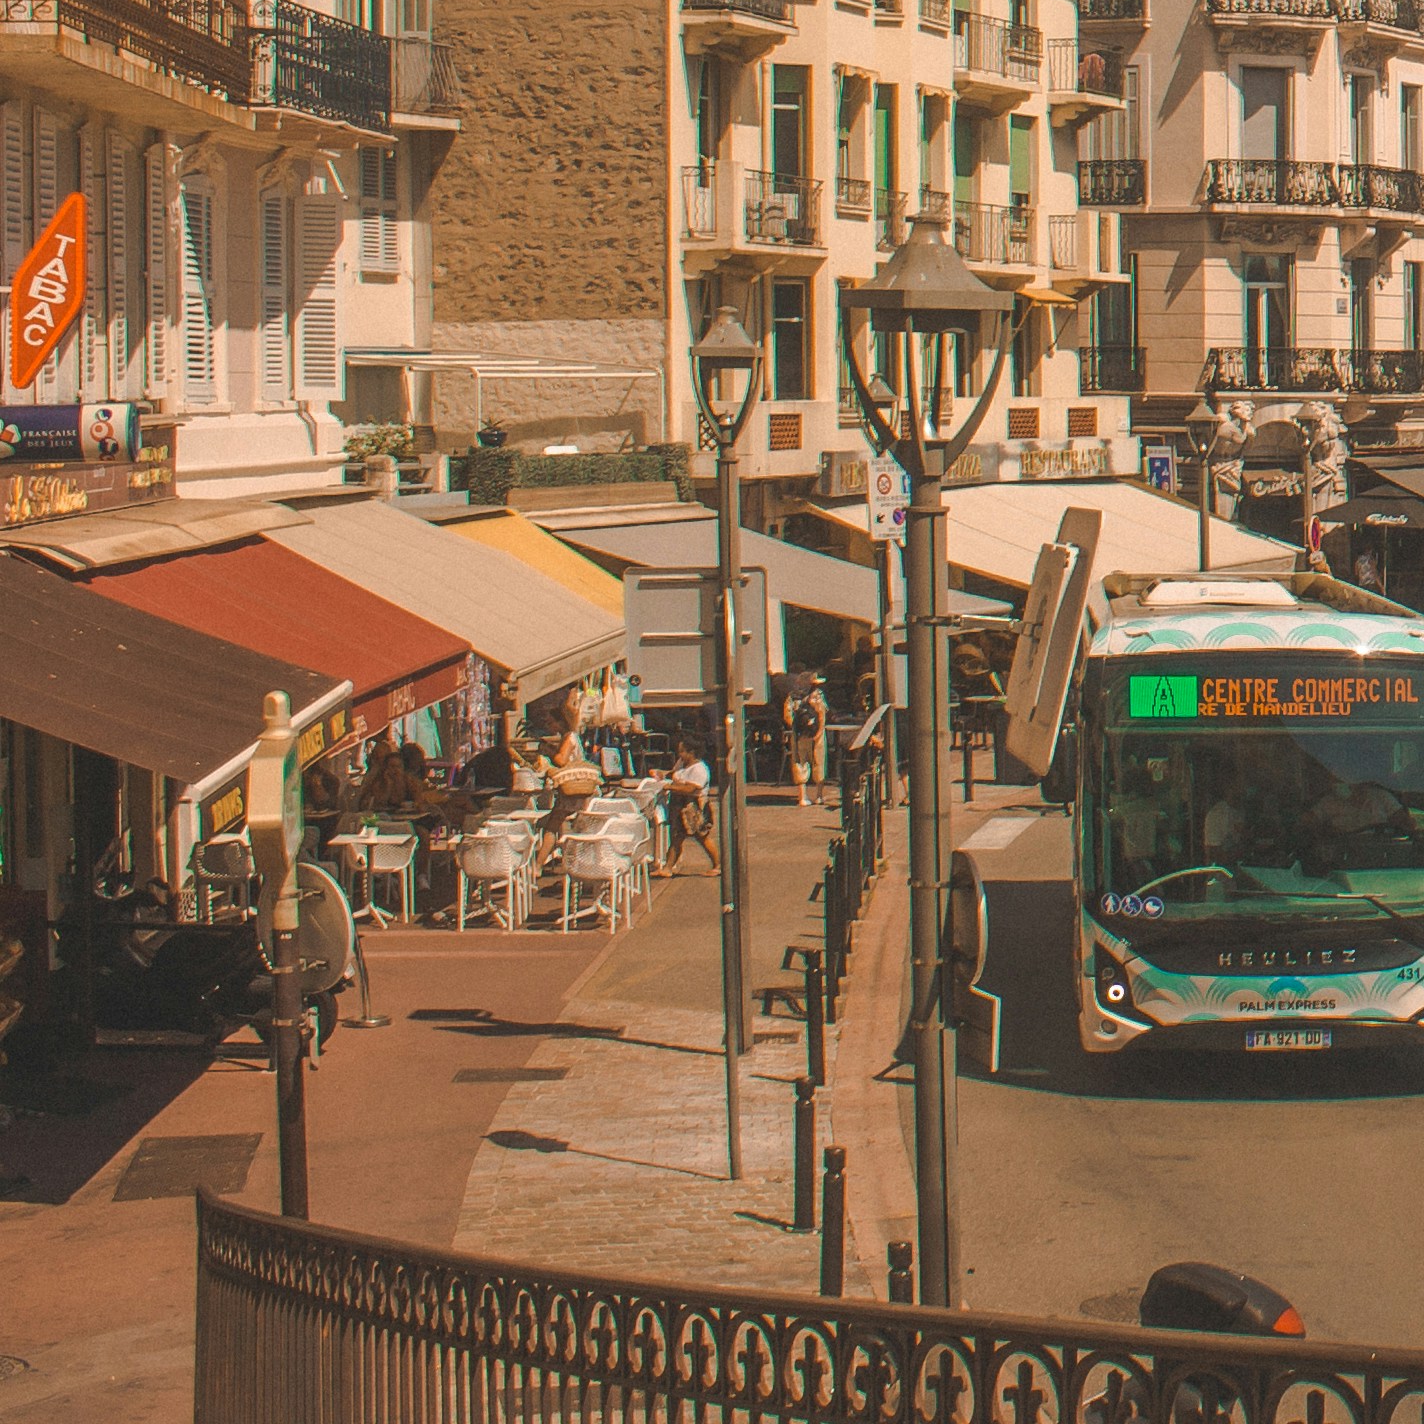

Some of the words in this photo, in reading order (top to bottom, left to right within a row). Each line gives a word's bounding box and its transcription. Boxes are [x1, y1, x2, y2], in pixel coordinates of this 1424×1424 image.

[24, 234, 76, 346] TABAC
[27, 440, 48, 448] DES
[50, 440, 74, 449] JEUX
[1021, 448, 1108, 475] RESTAURANT
[1152, 676, 1176, 717] A
[1202, 678, 1278, 703] CENTRE
[1292, 678, 1419, 704] COMMERCIAL
[1225, 702, 1247, 716] DE
[1253, 702, 1351, 716] MANDELIEU
[1218, 949, 1356, 967] HEULIEZ
[1397, 967, 1421, 981] 431
[1239, 1000, 1276, 1013] PALM
[1277, 999, 1336, 1012] EXPRESS
